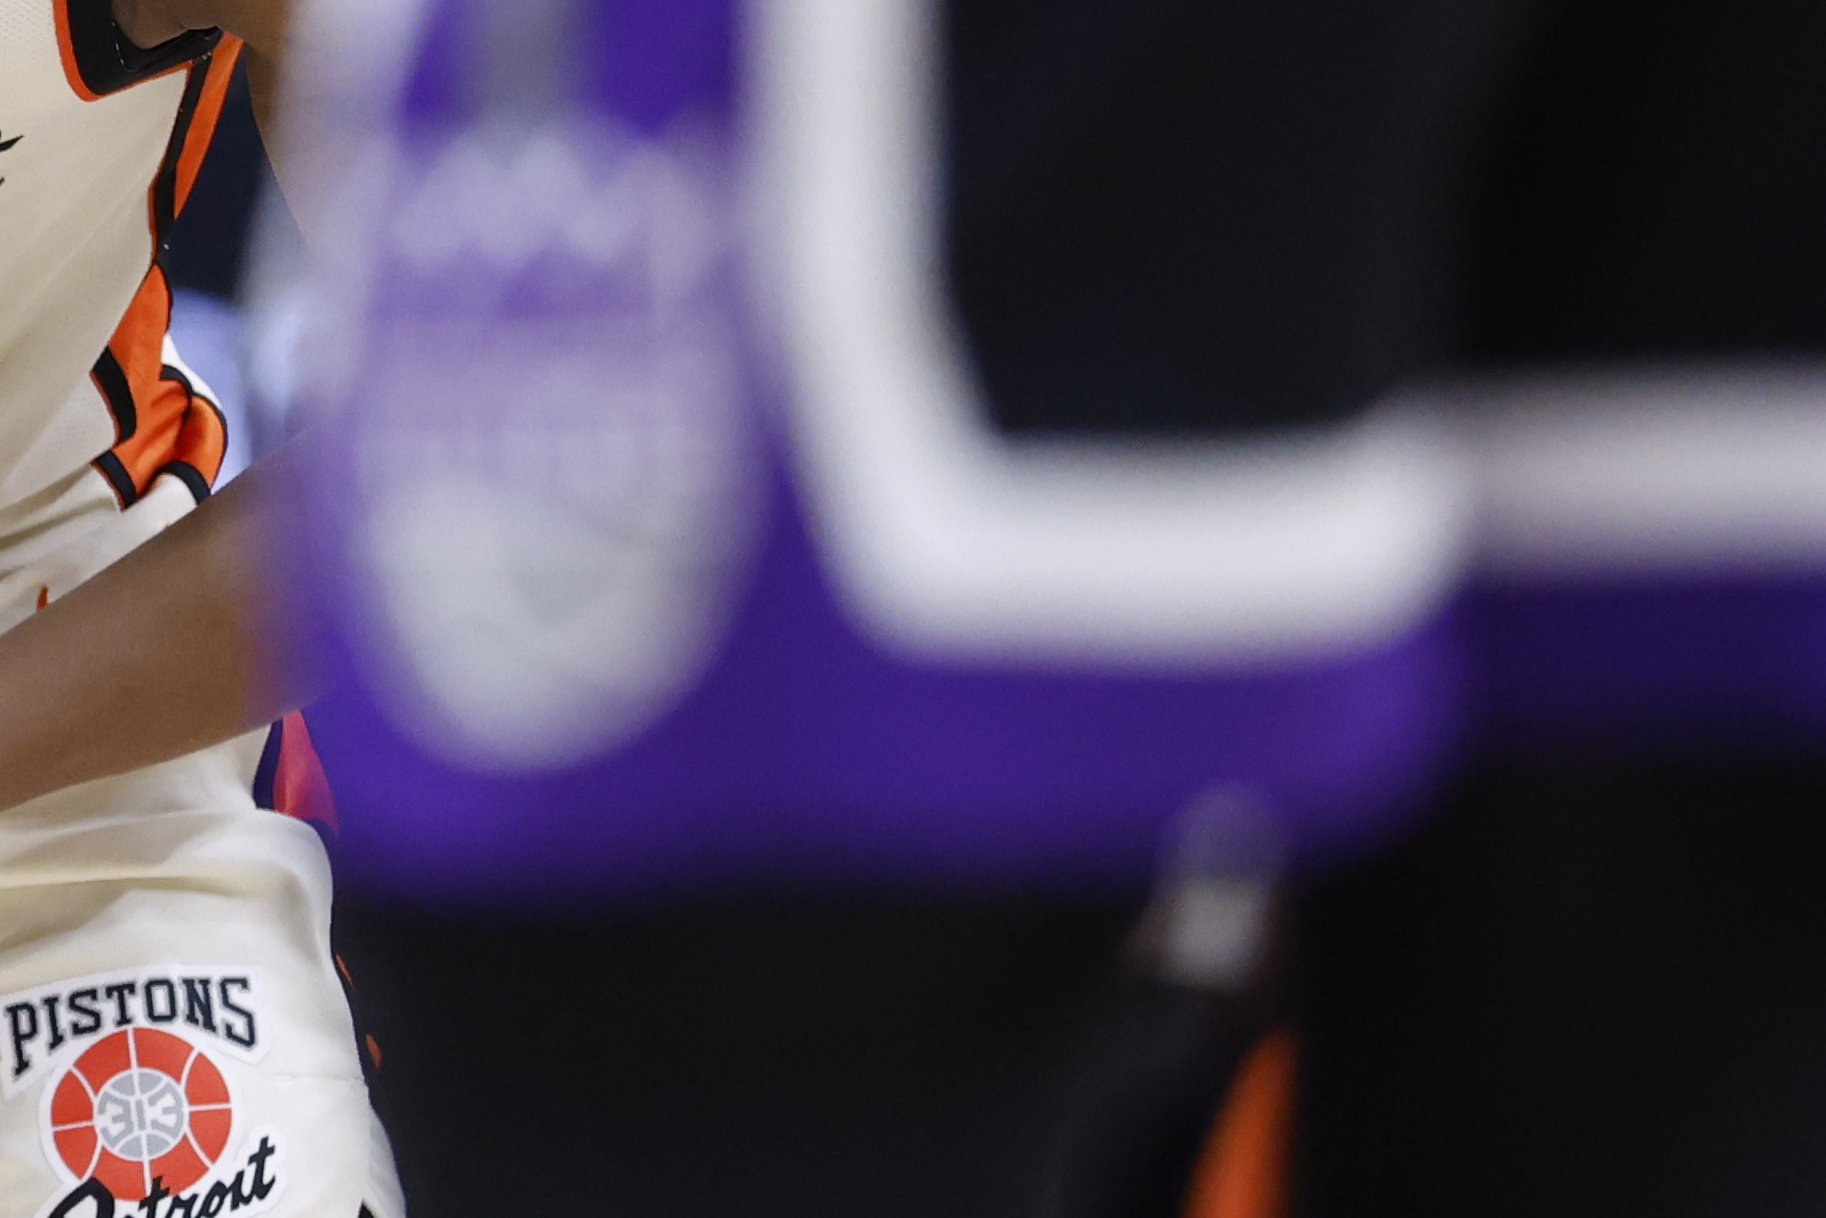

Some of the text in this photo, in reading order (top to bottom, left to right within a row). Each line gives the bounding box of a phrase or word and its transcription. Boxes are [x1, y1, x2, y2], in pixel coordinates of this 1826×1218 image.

[4, 975, 257, 1078] PISTONS
[97, 1094, 183, 1142] 313
[48, 1135, 276, 1218] Dtroit
